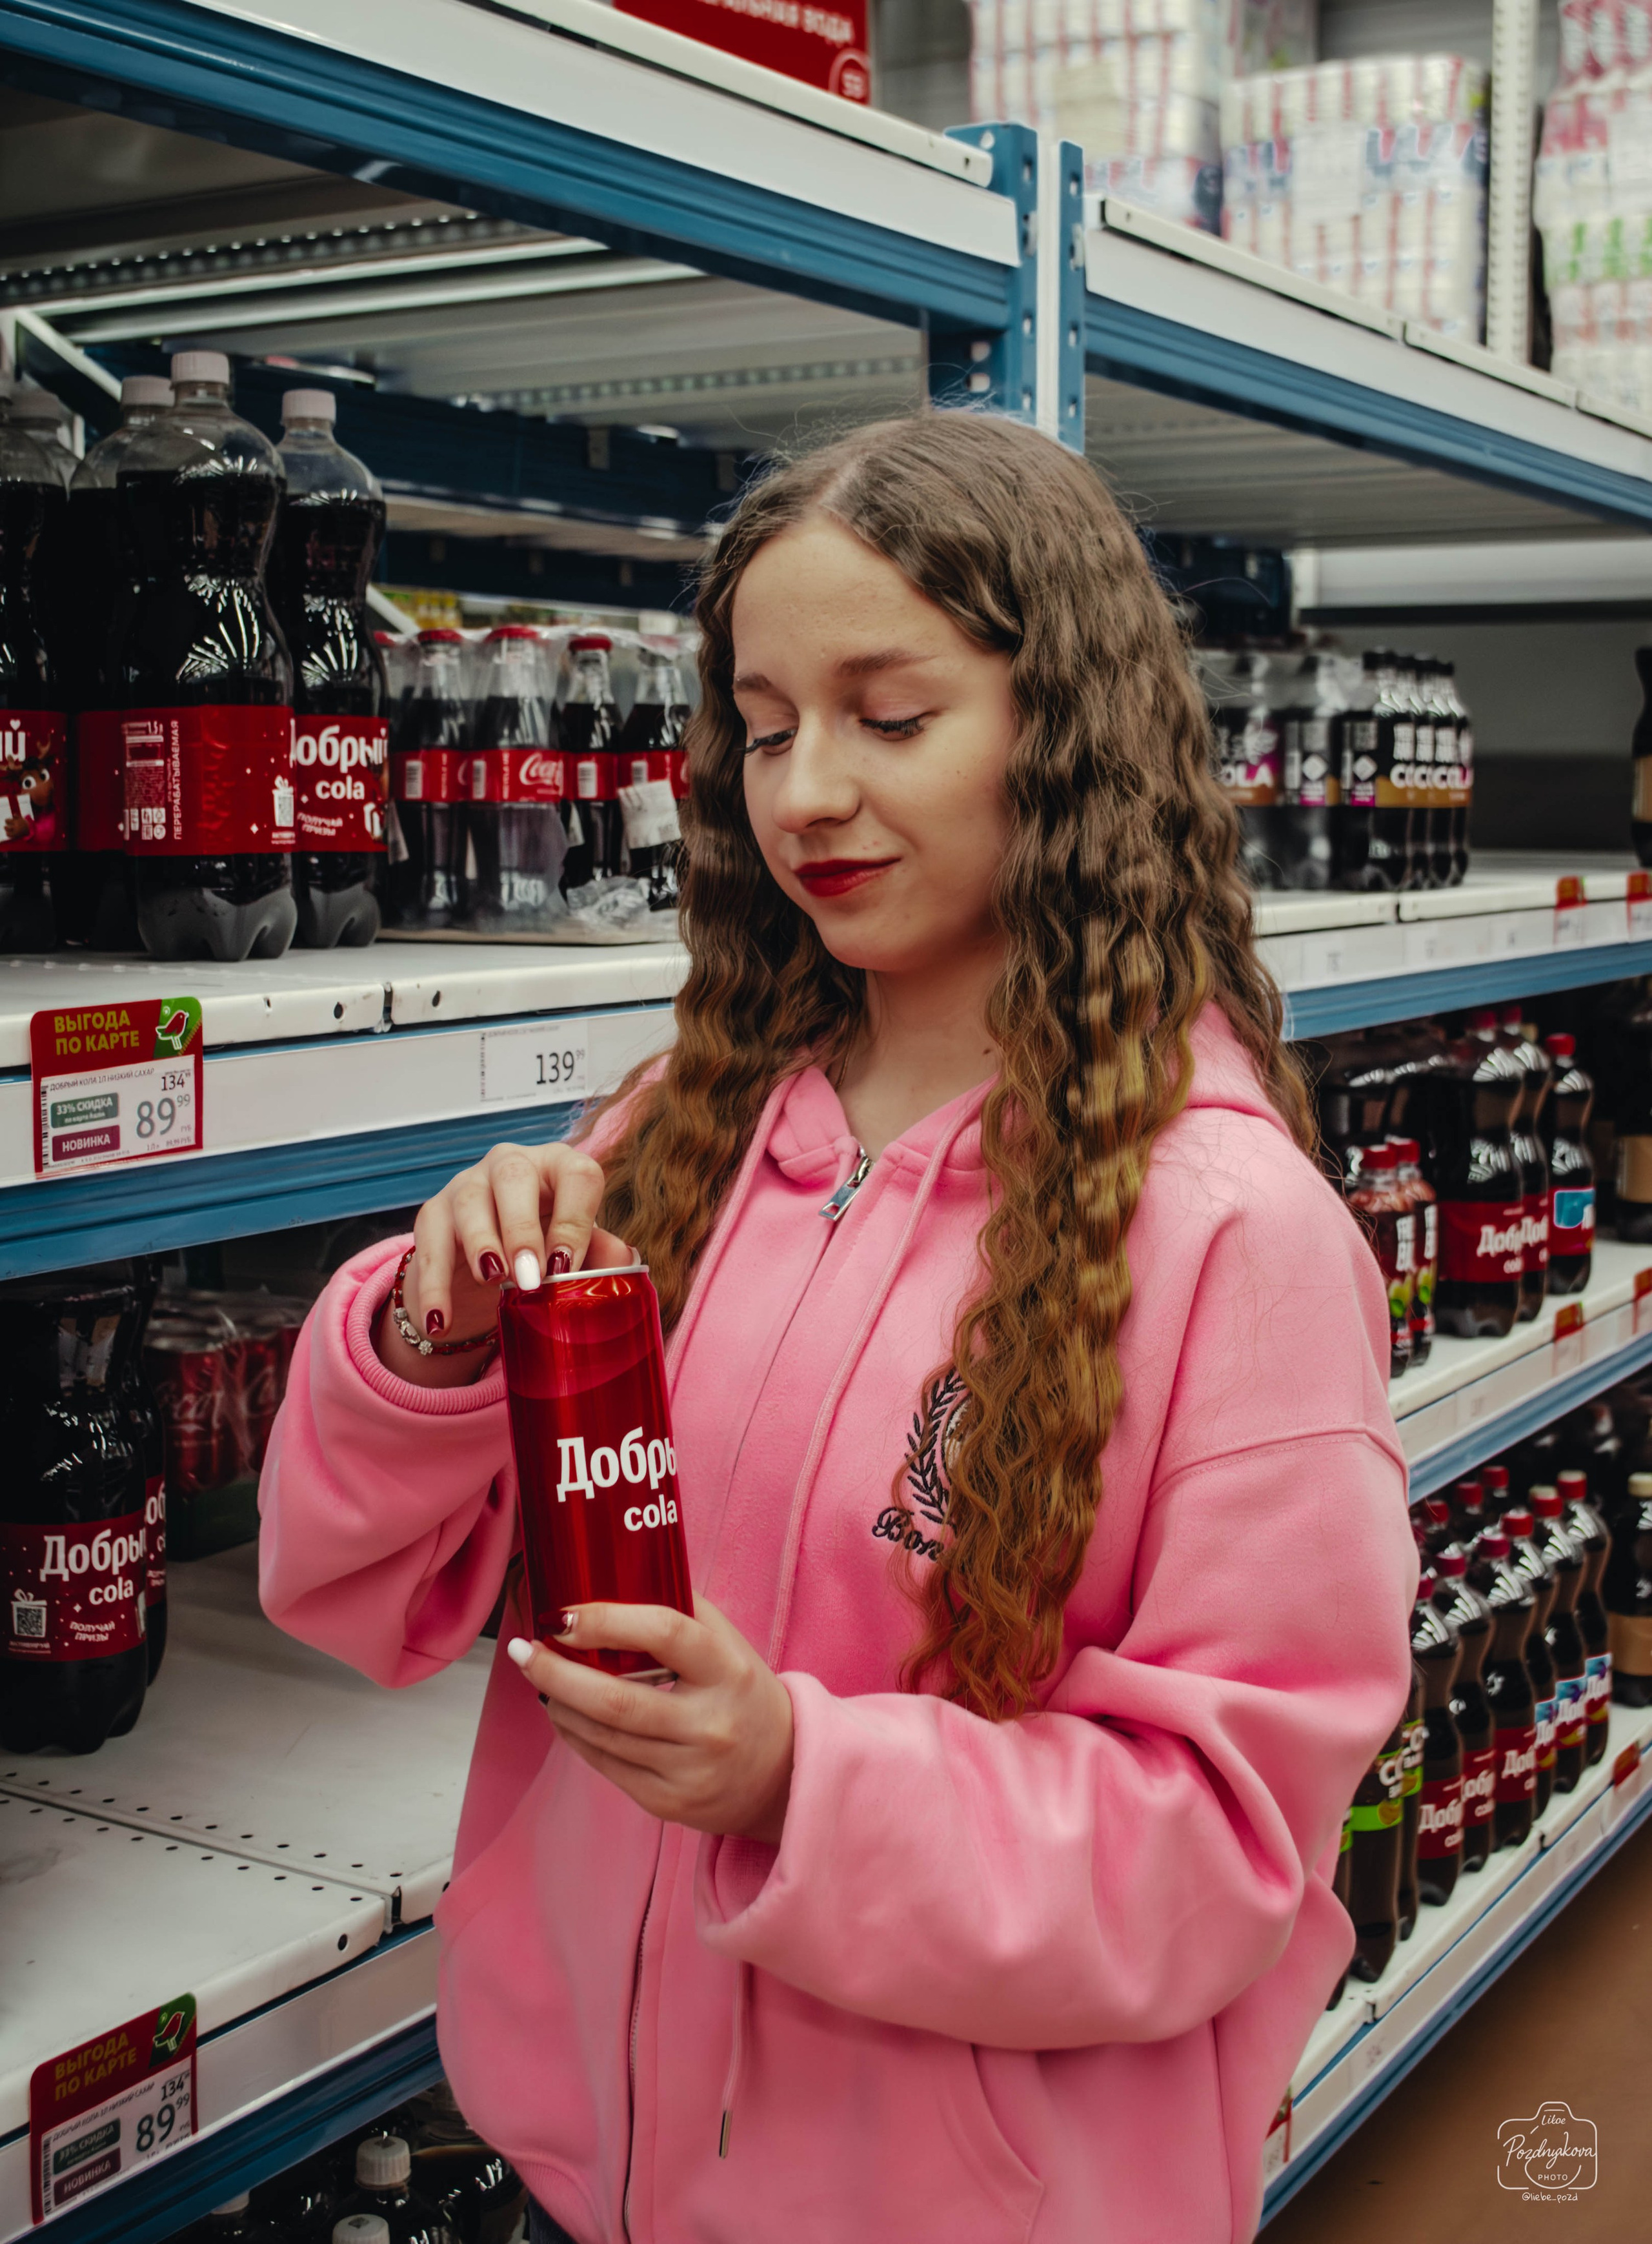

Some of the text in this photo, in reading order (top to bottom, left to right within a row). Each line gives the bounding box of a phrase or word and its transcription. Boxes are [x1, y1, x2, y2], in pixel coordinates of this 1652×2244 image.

[170, 720, 182, 840] ПЕРЕРАБАТЫВАЕМАЯ
[315, 775, 365, 800] cola
[54, 1009, 131, 1033] ВЫГОДА
[55, 1030, 140, 1056] ПО КАРТЕ
[50, 1078, 79, 1091] ДОБРЫЙ
[79, 1077, 97, 1087] КОЛА
[106, 1071, 134, 1083] НИЗКИЙ
[134, 1067, 155, 1078] САХАР
[536, 1050, 575, 1085] 139
[161, 1074, 185, 1092] 134
[76, 1097, 113, 1112] СКИДКА
[136, 1094, 191, 1139] 89 99
[62, 1133, 111, 1153] НОВИНКА
[623, 1493, 678, 1531] cola
[88, 1576, 134, 1606] cola
[54, 2031, 129, 2081] ВЫГОДА
[54, 2079, 81, 2102] ПО
[84, 2047, 137, 2088] КАРТЕ
[161, 2075, 185, 2102] 134
[136, 2103, 176, 2152] 89
[176, 2092, 190, 2111] 99
[63, 2159, 112, 2194] НОВИНКА
